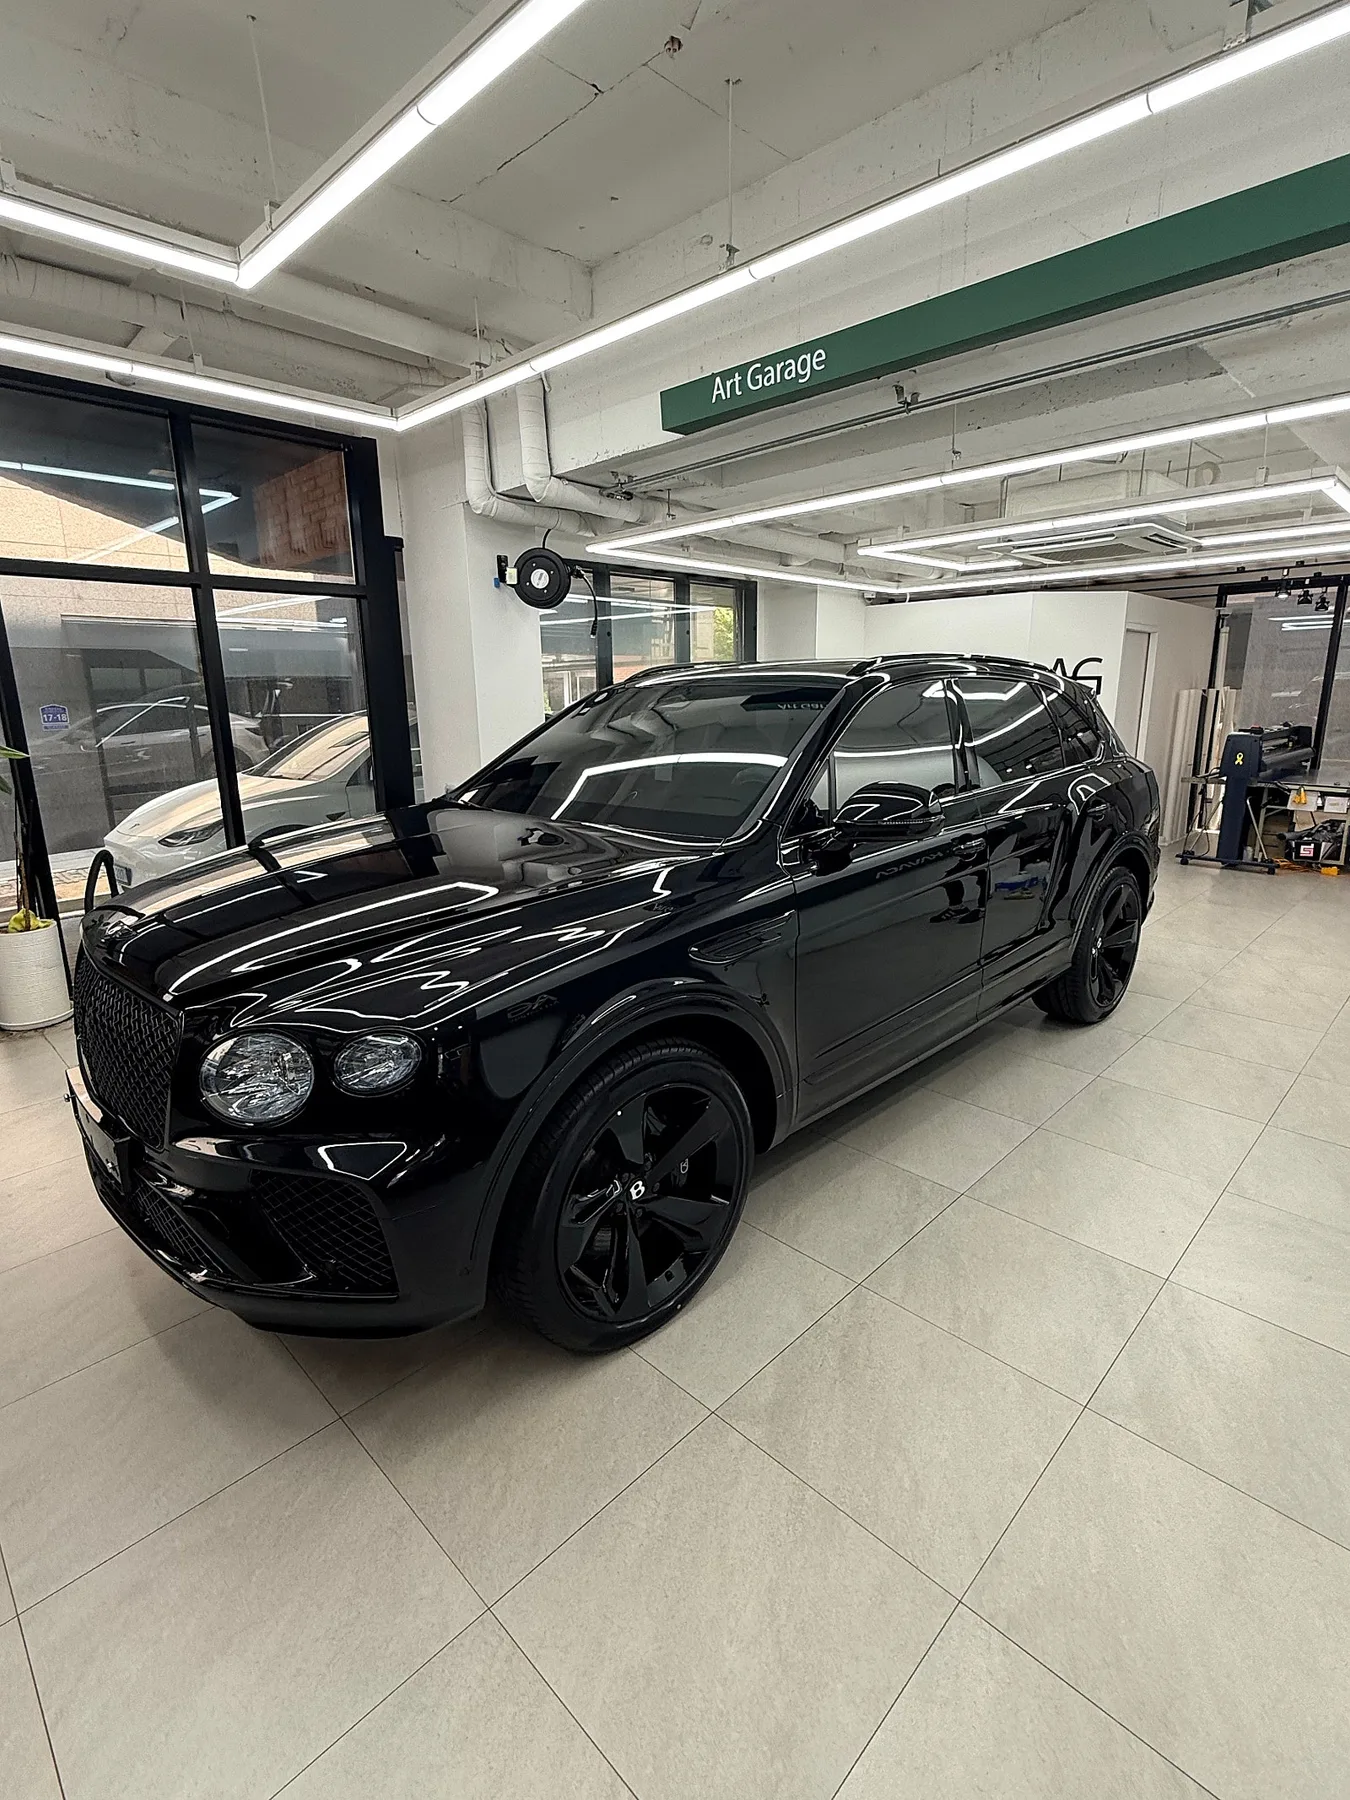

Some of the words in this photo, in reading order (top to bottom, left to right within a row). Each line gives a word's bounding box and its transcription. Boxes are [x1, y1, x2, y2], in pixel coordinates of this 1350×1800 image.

[711, 371, 743, 404] Art
[746, 348, 827, 391] Garage
[43, 713, 67, 722] 17-18
[629, 1180, 646, 1201] B
